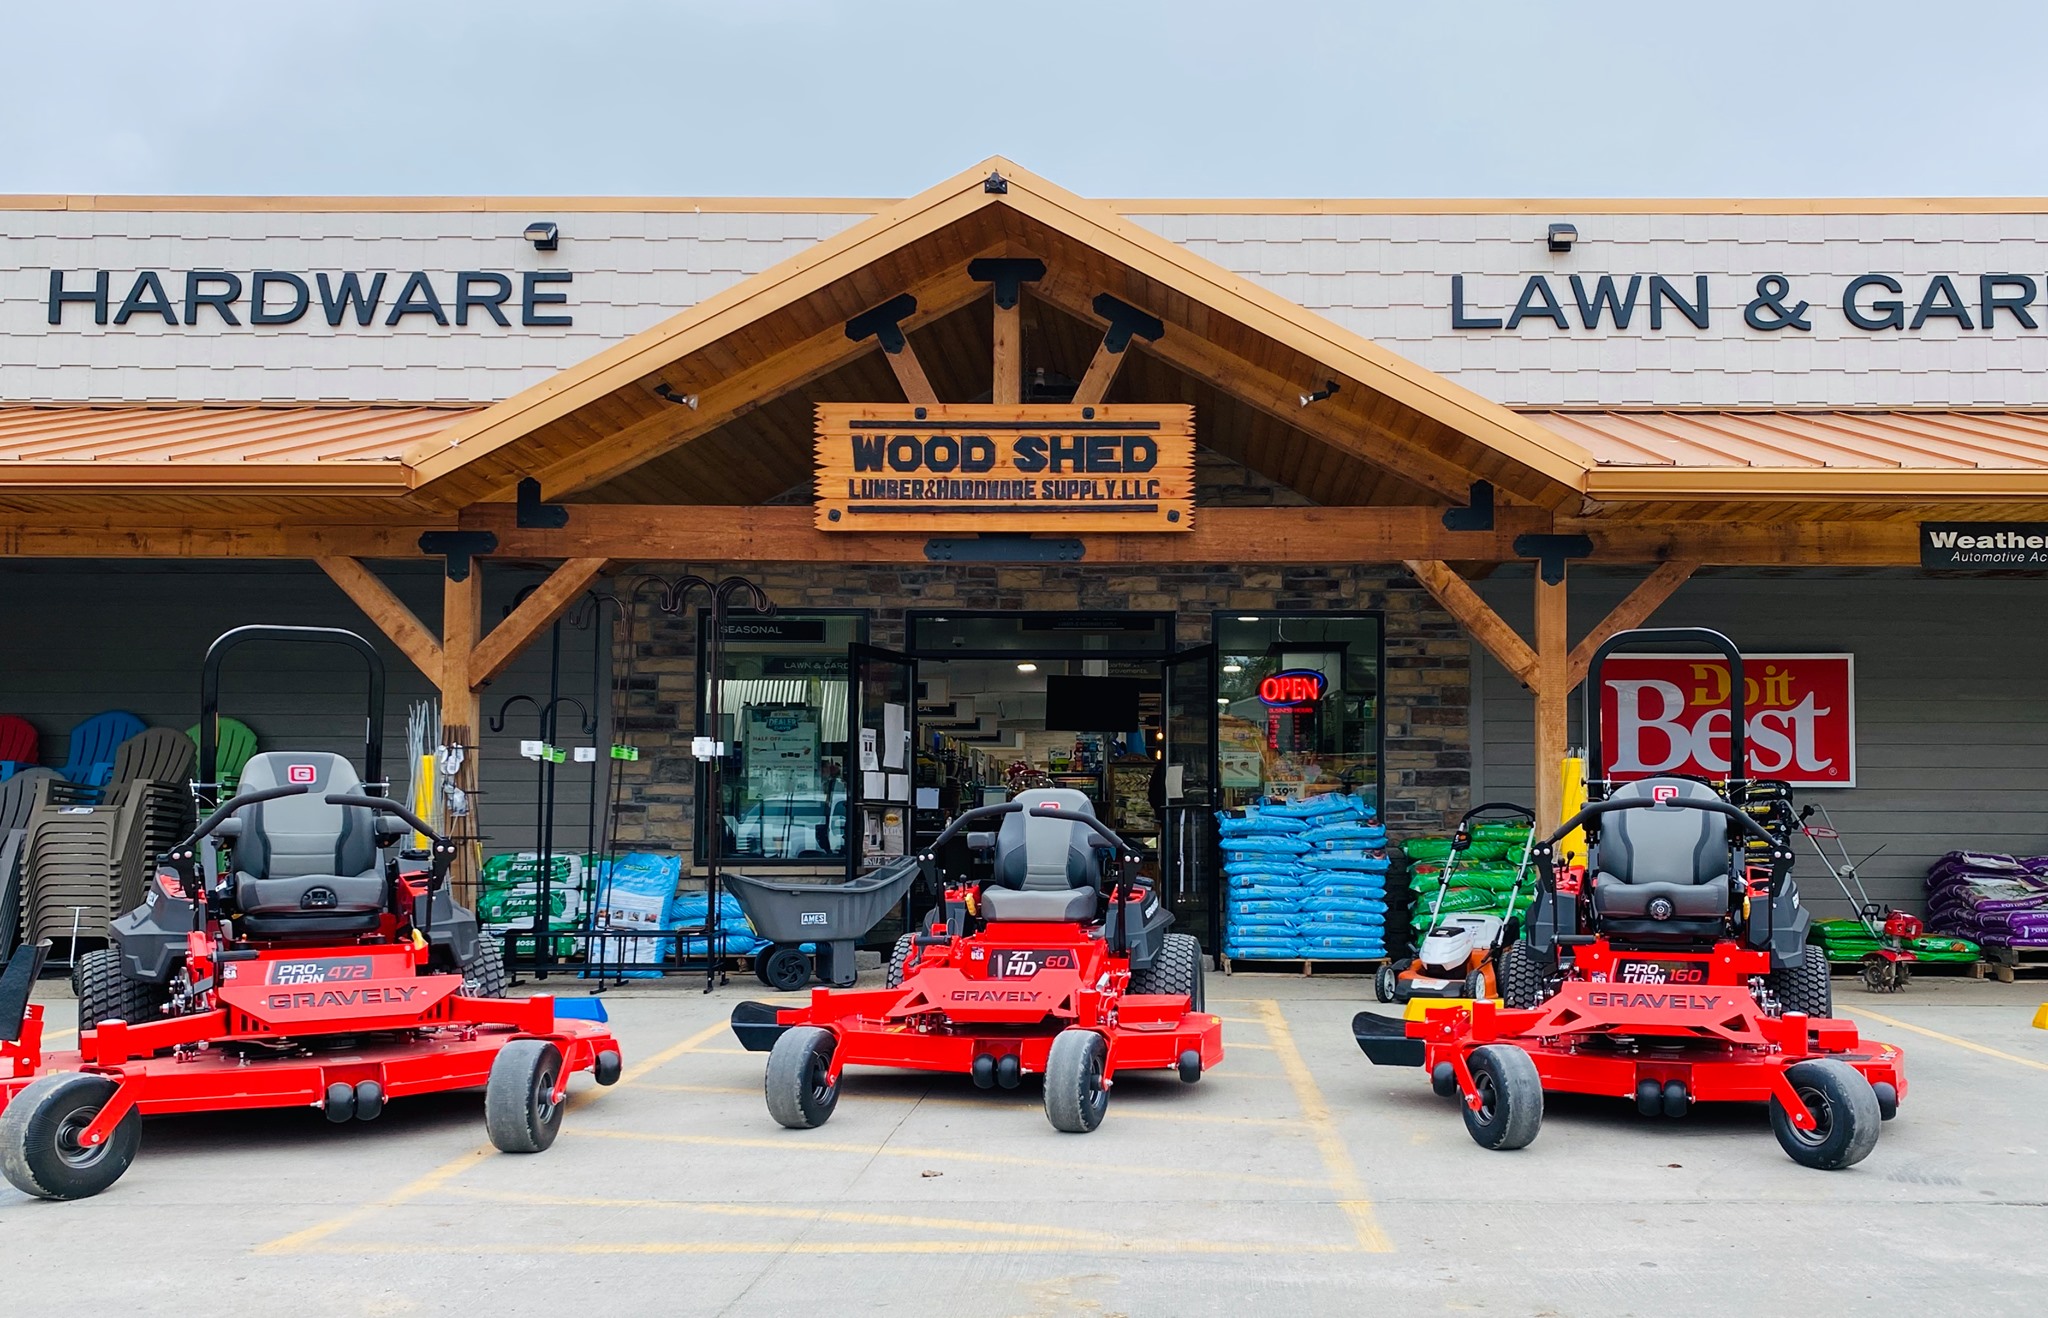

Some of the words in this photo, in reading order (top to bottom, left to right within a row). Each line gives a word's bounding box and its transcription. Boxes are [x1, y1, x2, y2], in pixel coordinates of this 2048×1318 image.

[48, 270, 573, 327] HARDWARE
[1452, 274, 1710, 330] LAWN
[1743, 274, 1812, 331] &
[1842, 274, 2048, 331] GAR
[851, 435, 997, 473] WOOD
[1012, 435, 1158, 474] SHED
[1951, 551, 2025, 562] Automotive
[720, 625, 782, 634] SEASONAL
[1261, 677, 1319, 701] OPEN
[1690, 664, 1760, 706] Do
[1763, 665, 1796, 706] it
[769, 718, 797, 726] DEALER
[1605, 680, 1833, 773] Best
[803, 914, 825, 922] AMES
[971, 951, 985, 961] USA
[1010, 951, 1033, 961] ZT
[278, 963, 323, 975] PRO-
[327, 965, 367, 979] 472
[1624, 963, 1665, 974] PRO-
[277, 973, 325, 985] TURN
[1623, 973, 1666, 985] TURN
[1669, 969, 1703, 982] 160
[268, 986, 418, 1010] GRAVELY
[950, 990, 1043, 1002] GRAVELY
[1588, 992, 1722, 1010] GRAVELY
